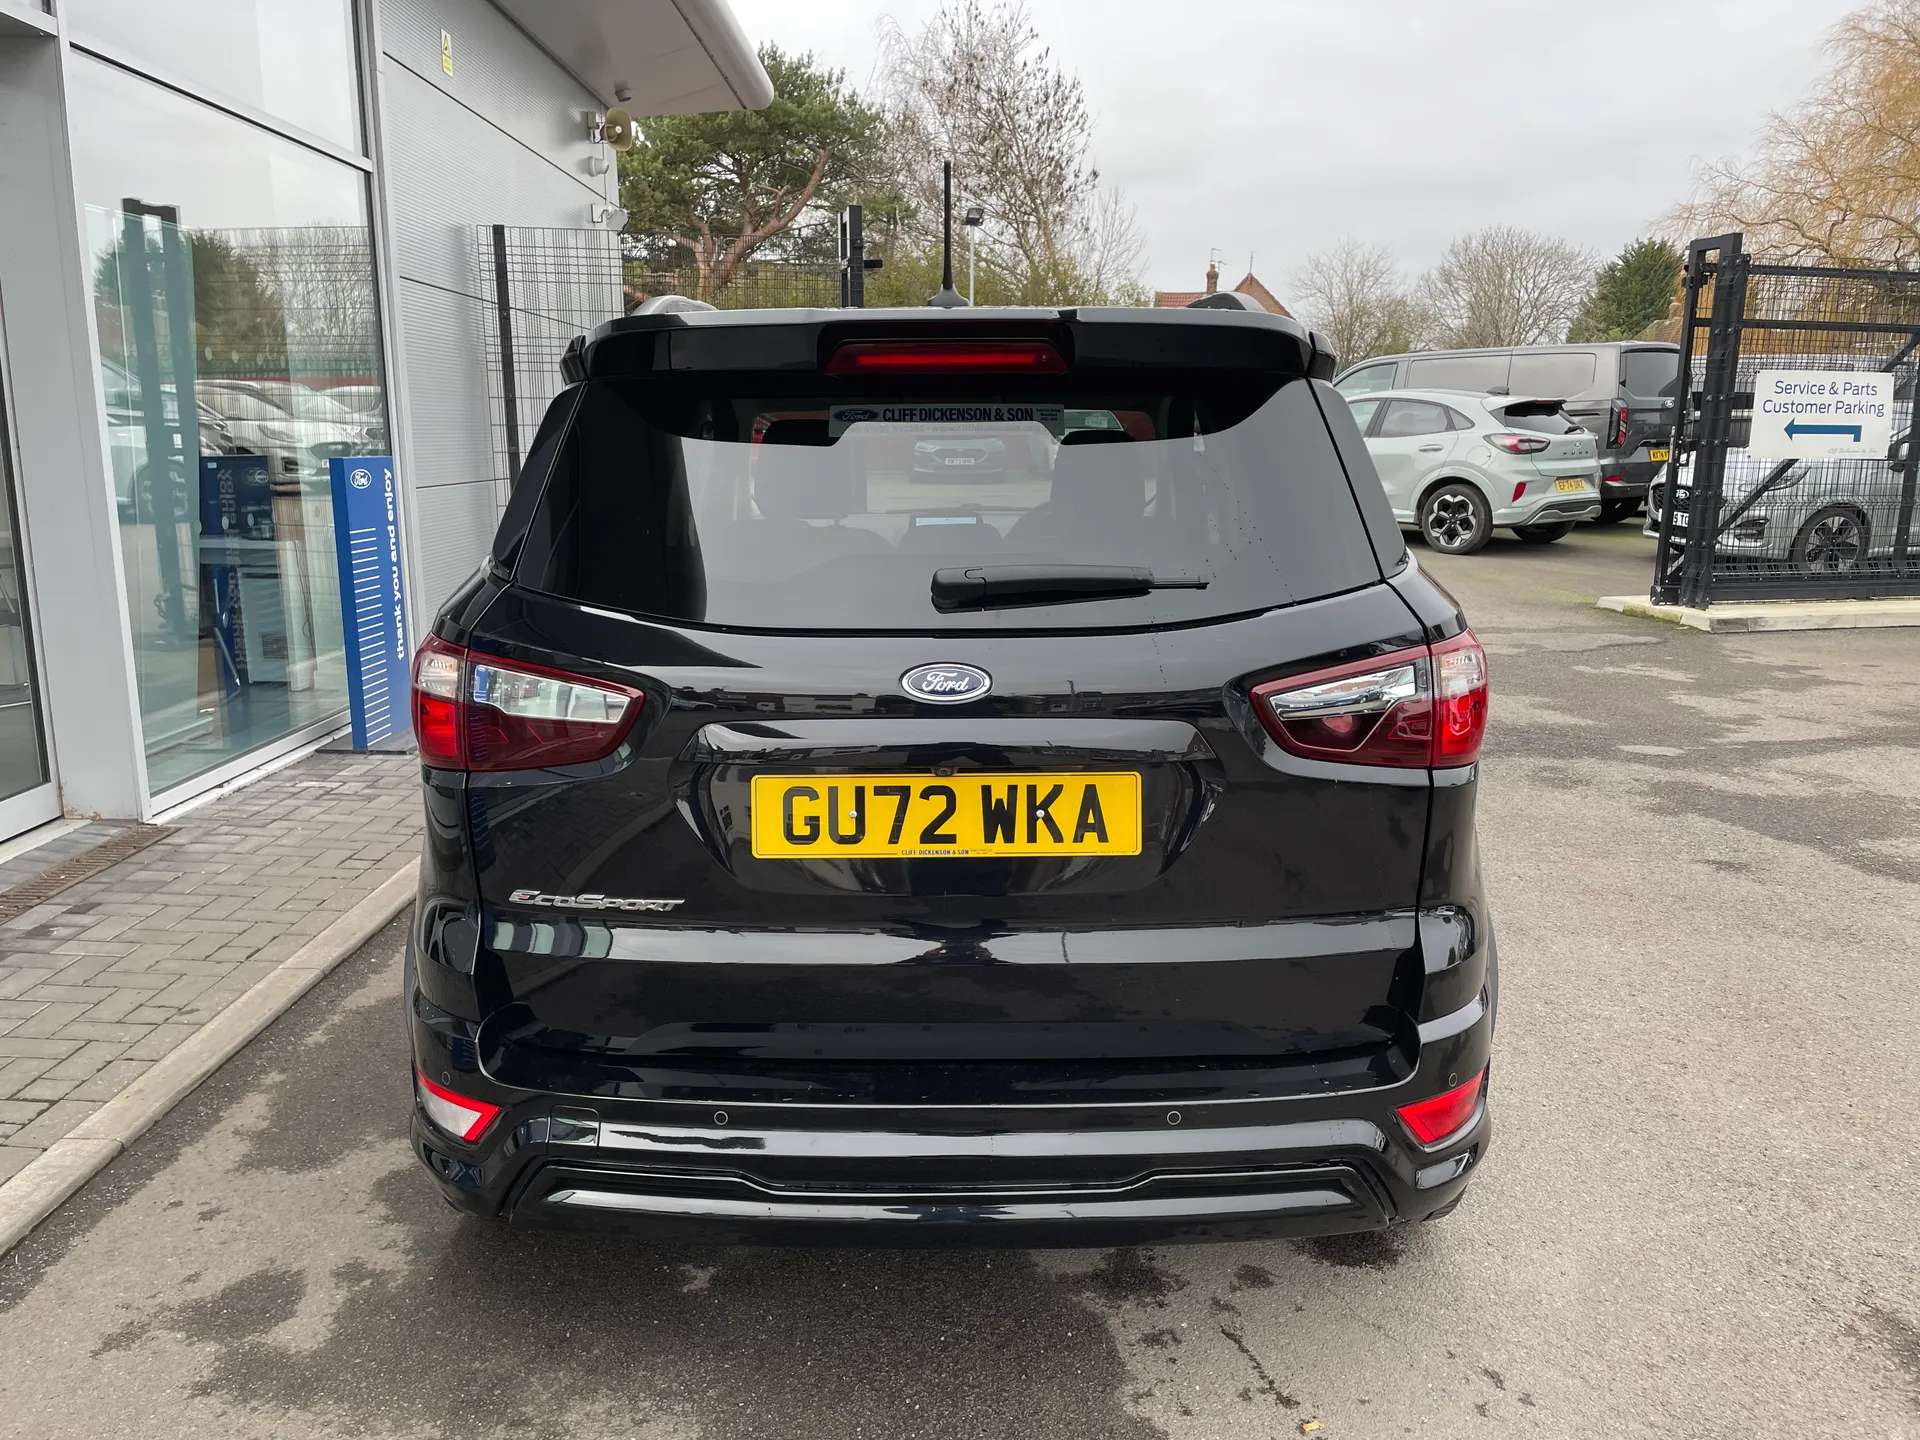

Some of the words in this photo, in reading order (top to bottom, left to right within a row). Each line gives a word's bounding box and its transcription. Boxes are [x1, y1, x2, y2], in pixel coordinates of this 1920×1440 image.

[1774, 380, 1825, 395] Service
[1828, 382, 1839, 395] &
[1843, 382, 1878, 396] Parts
[882, 408, 916, 422] CLIFF
[918, 408, 991, 422] DICKENSON
[994, 408, 1005, 421] &
[1007, 408, 1034, 421] SON
[1762, 399, 1832, 414] Customer
[1835, 401, 1885, 417] Parking
[383, 467, 394, 522] enjoy
[387, 525, 397, 562] and
[392, 566, 402, 600] you
[394, 604, 404, 661] thank
[922, 671, 970, 692] Ford
[782, 784, 957, 845] GU72
[981, 783, 1110, 844] WKA
